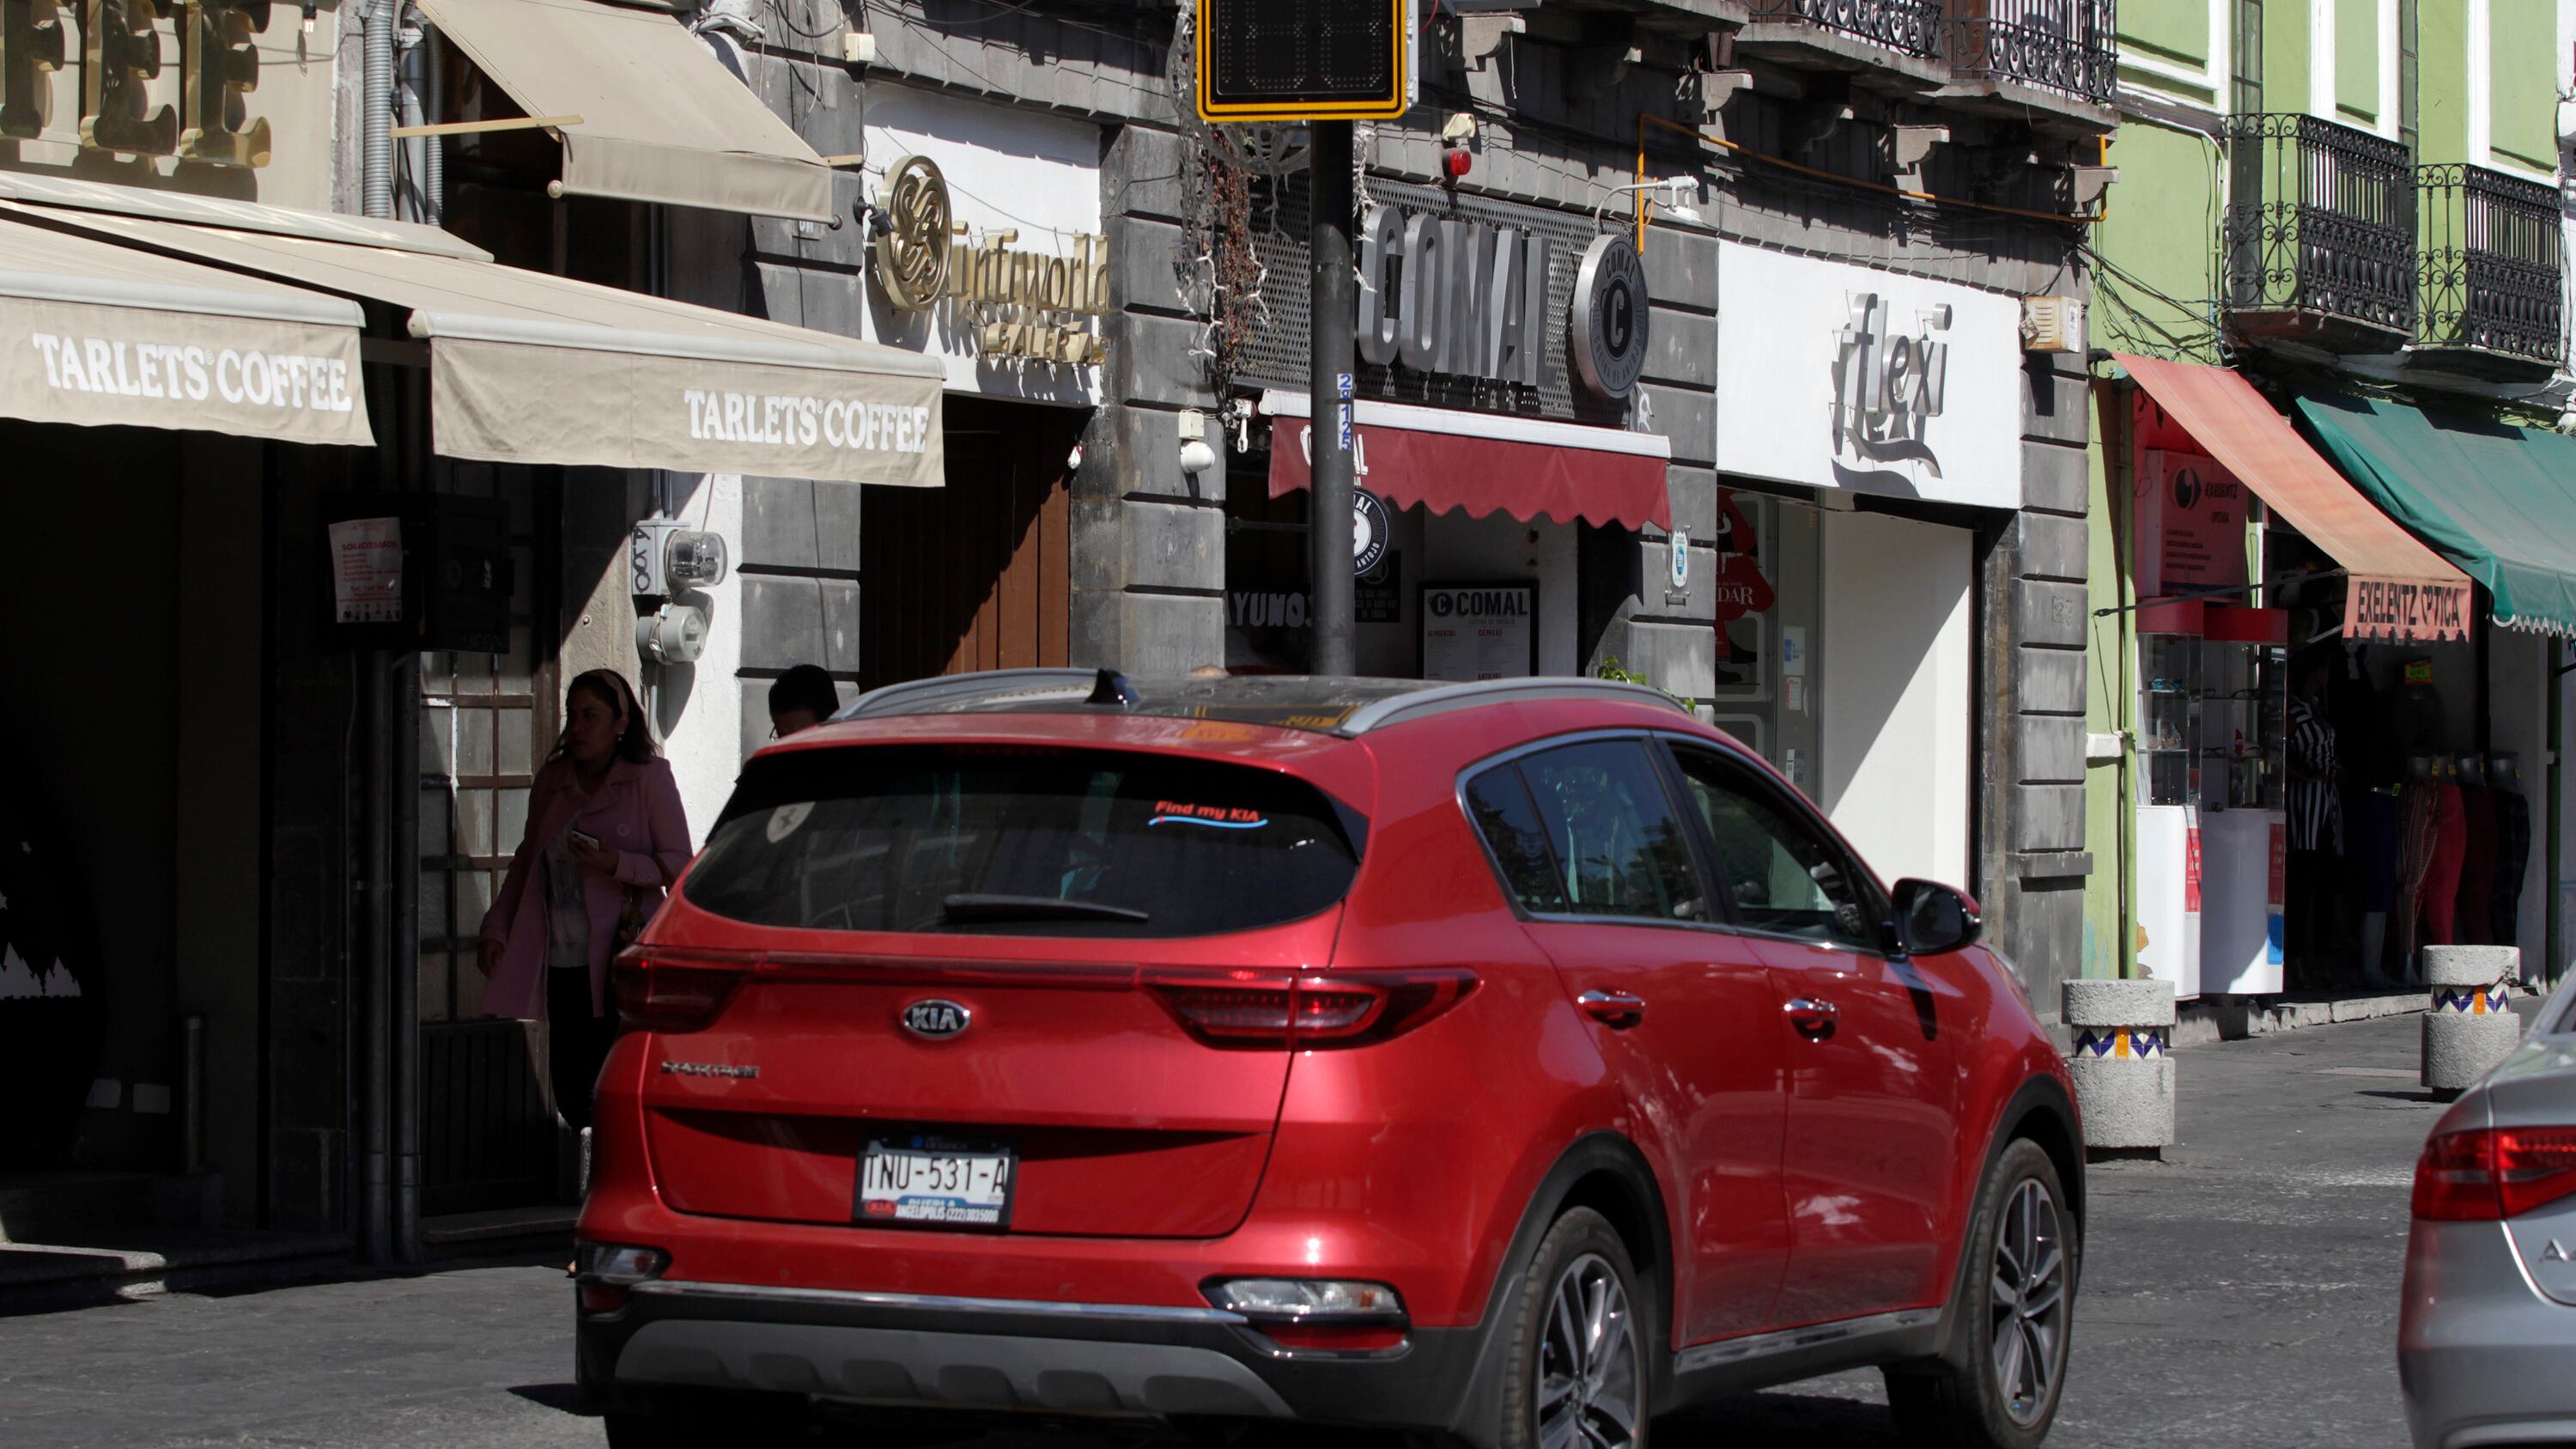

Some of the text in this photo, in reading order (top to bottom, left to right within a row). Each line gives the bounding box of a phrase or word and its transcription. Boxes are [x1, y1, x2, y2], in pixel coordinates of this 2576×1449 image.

[1605, 248, 1636, 283] COMAL
[1358, 205, 1557, 387] COMAL
[1844, 293, 1952, 417] flexi
[216, 348, 353, 411] COFFEE
[823, 399, 929, 454] COFFEE
[1456, 591, 1528, 616] COMAL
[2357, 581, 2417, 625] EXELENTZ
[1155, 801, 1260, 822] Find my KIA
[912, 1007, 958, 1031] KIA
[866, 1154, 1005, 1193] TNU-531-A
